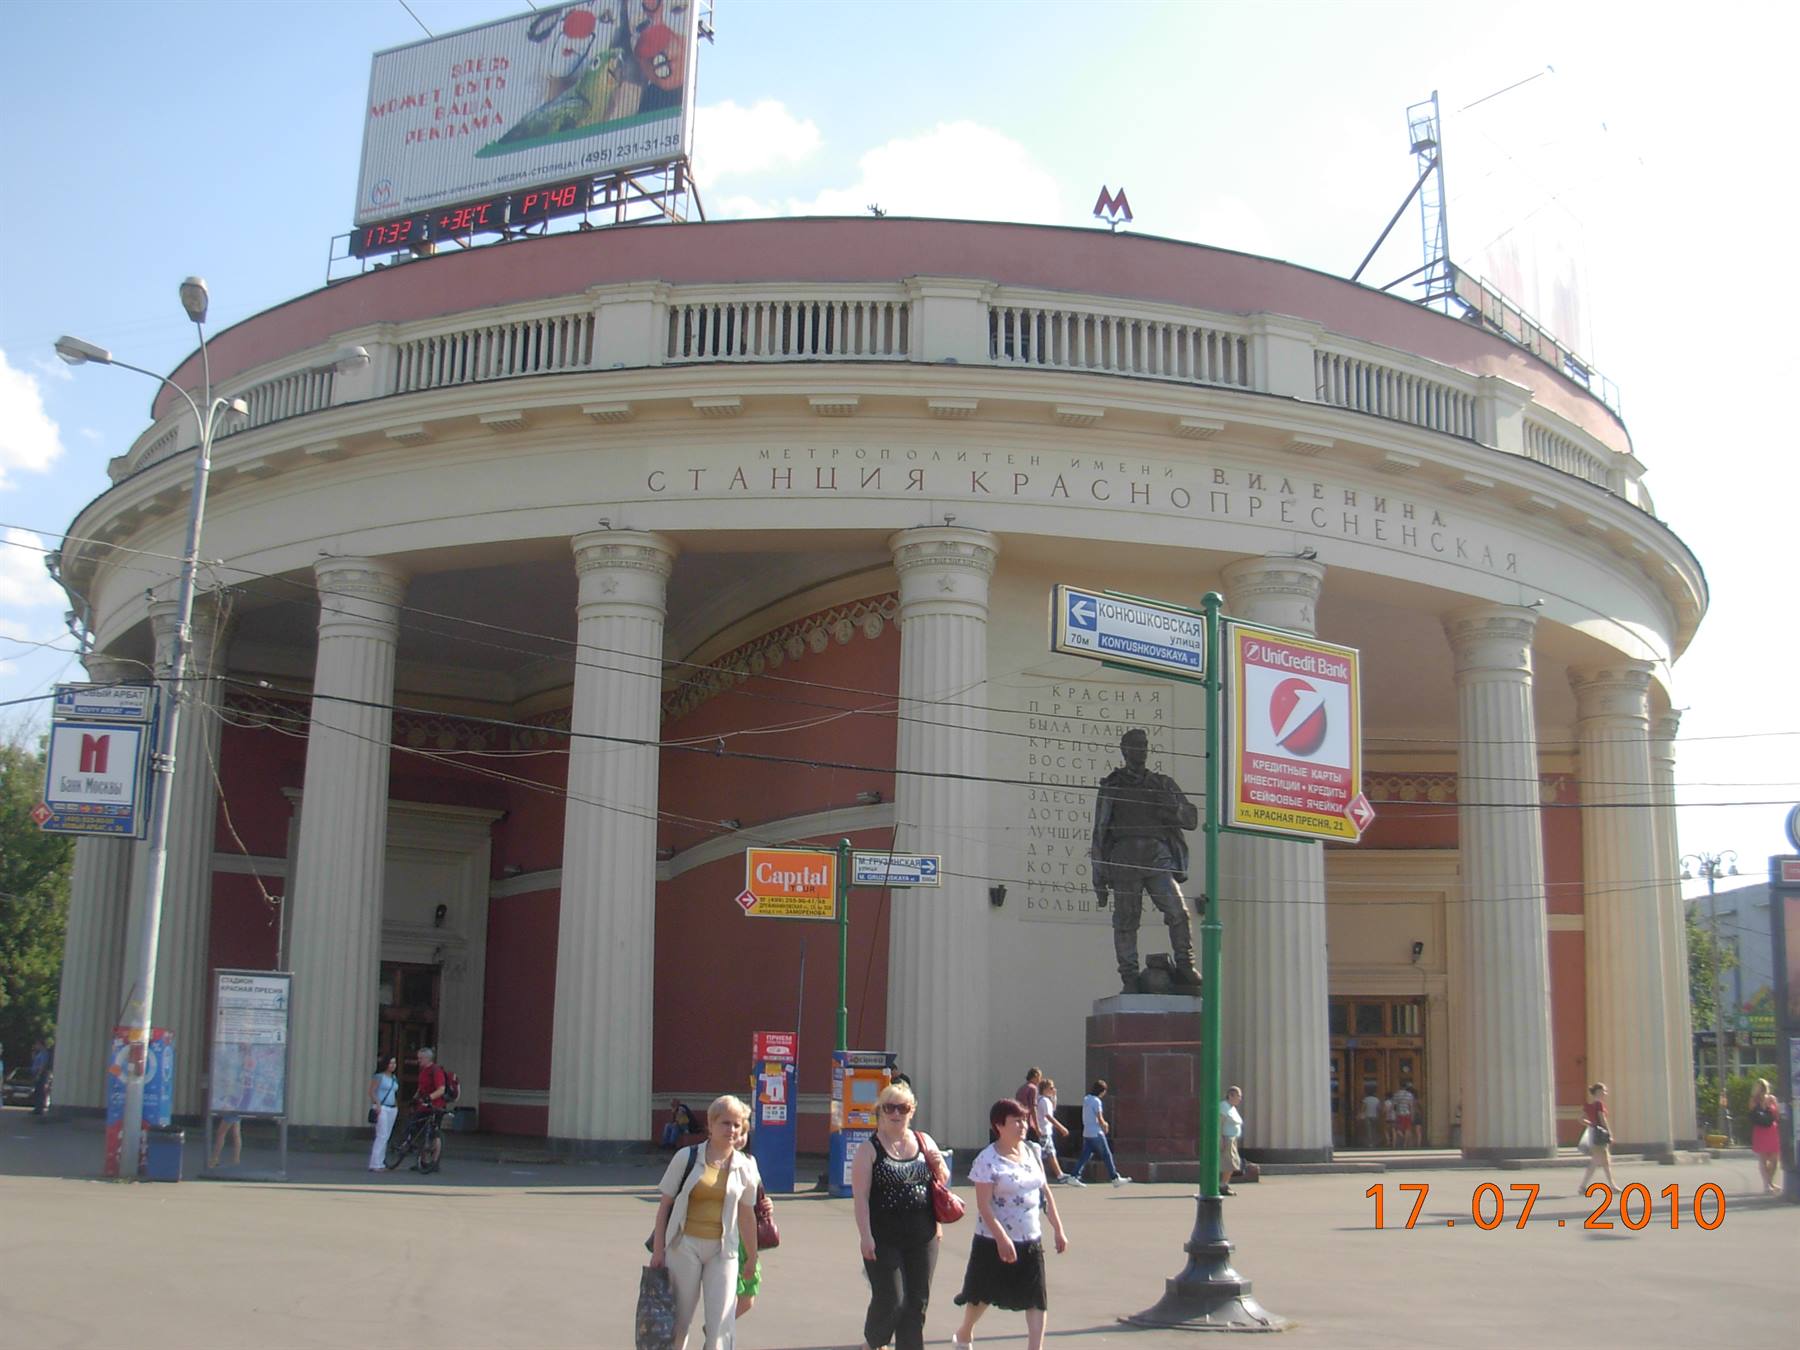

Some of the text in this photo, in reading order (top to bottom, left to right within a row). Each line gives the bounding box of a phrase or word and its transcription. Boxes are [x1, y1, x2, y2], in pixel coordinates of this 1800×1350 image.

[616, 134, 680, 158] 231-31-38
[365, 219, 412, 248] 17:32
[758, 448, 1040, 466] МЕТРОПОЛИТЕН
[1070, 457, 1174, 478] ИМЕНИ
[647, 466, 1518, 573] СТАНЦИЯ КРАСНОПРЕСНЕНСКАЯ
[1098, 603, 1201, 637] КОНЮШКОВСКАЯ
[1071, 633, 1090, 646] 70м
[1101, 635, 1188, 663] KONYUSHKOVSKAYA
[1169, 635, 1201, 649] улица
[1261, 646, 1316, 673] UniCredit
[1317, 658, 1348, 679] Bank
[1052, 686, 1160, 702] КРАСНАЯ
[1029, 701, 1163, 720] ПРЕСНЯ
[1029, 718, 1072, 733] БЫЛА
[1252, 759, 1343, 783] КРЕДИТНЫЕ КАРТЫ
[1028, 789, 1086, 804] ЗДЕСЬ
[1244, 773, 1347, 799] ИНВЕСТИЦИИ КРЕДИТЫ
[1249, 790, 1344, 813] СЕЙФОВЫЕ ЯЧЕЙКИ
[1253, 809, 1294, 823] КРАСНАЯ
[1333, 820, 1345, 831] 21
[755, 862, 828, 892] Capital
